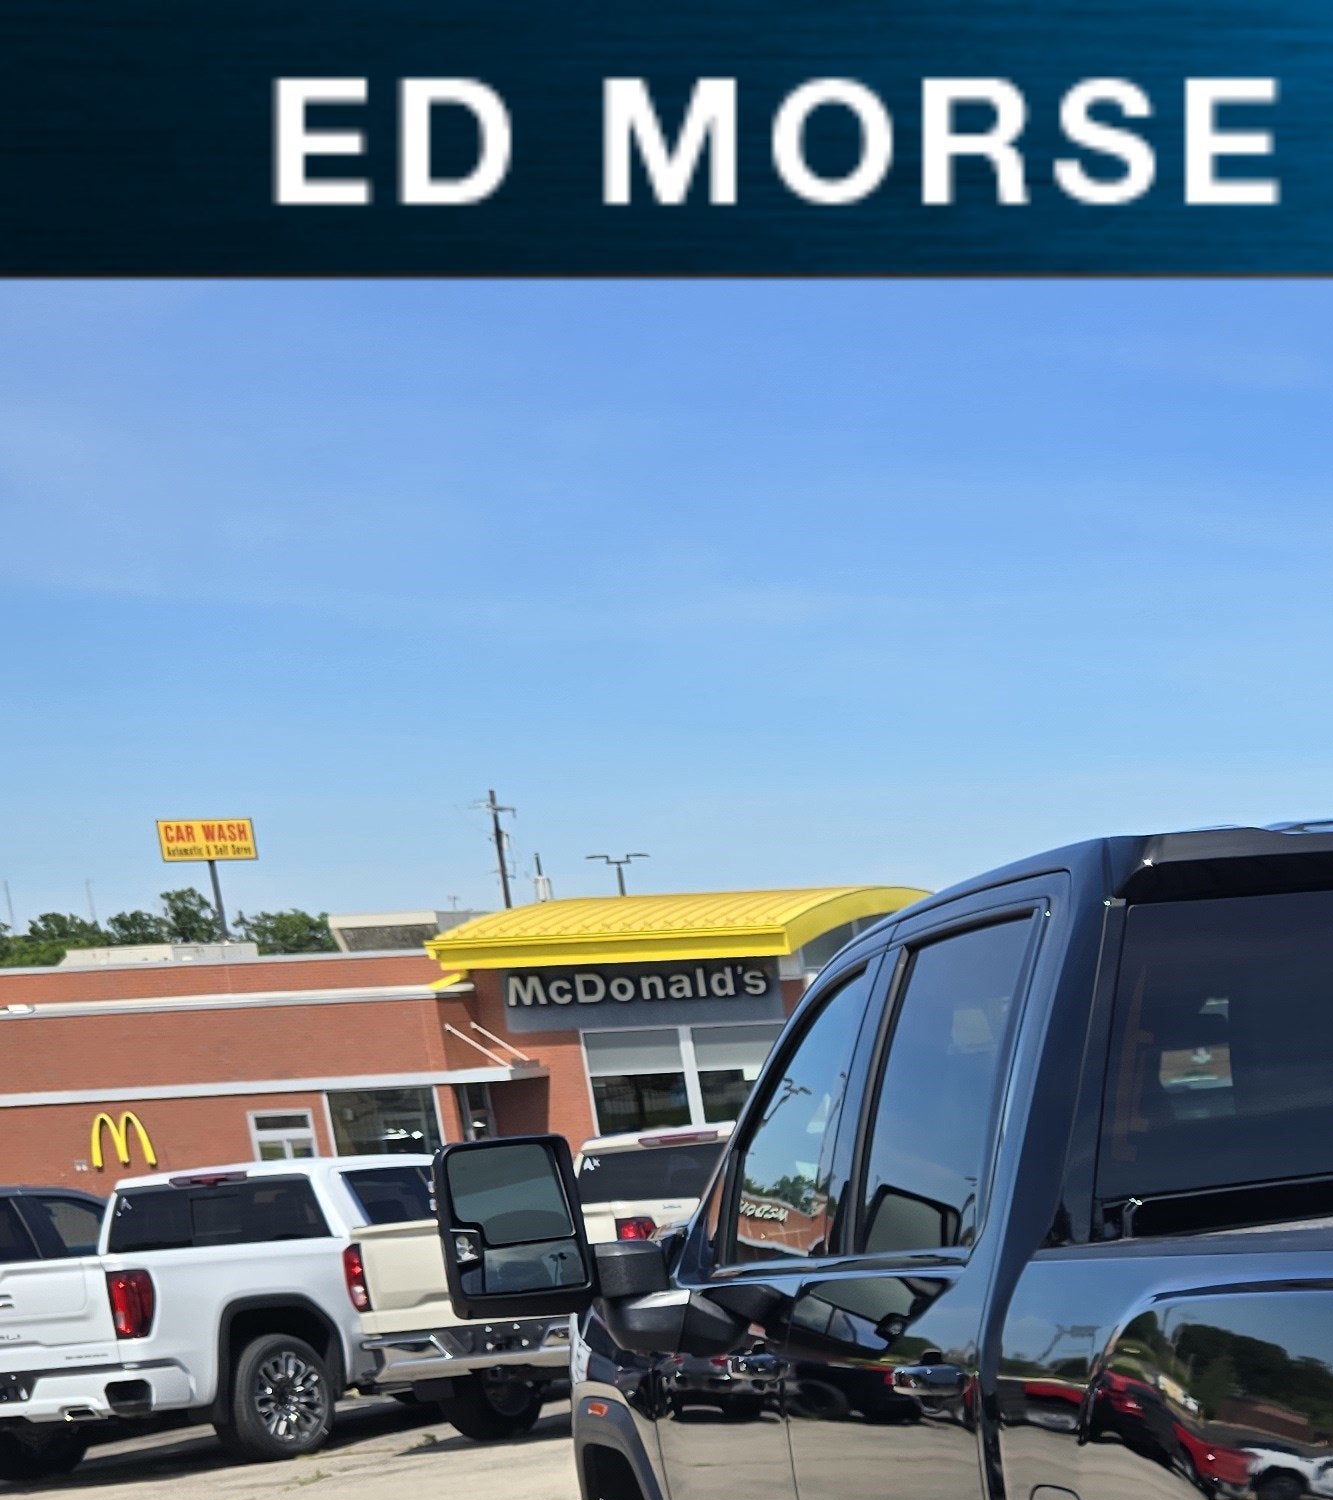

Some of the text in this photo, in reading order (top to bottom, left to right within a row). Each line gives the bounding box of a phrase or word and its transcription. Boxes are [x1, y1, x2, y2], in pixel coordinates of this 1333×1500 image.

[163, 823, 249, 843] CAR WASH
[507, 964, 768, 1007] McDonald's
